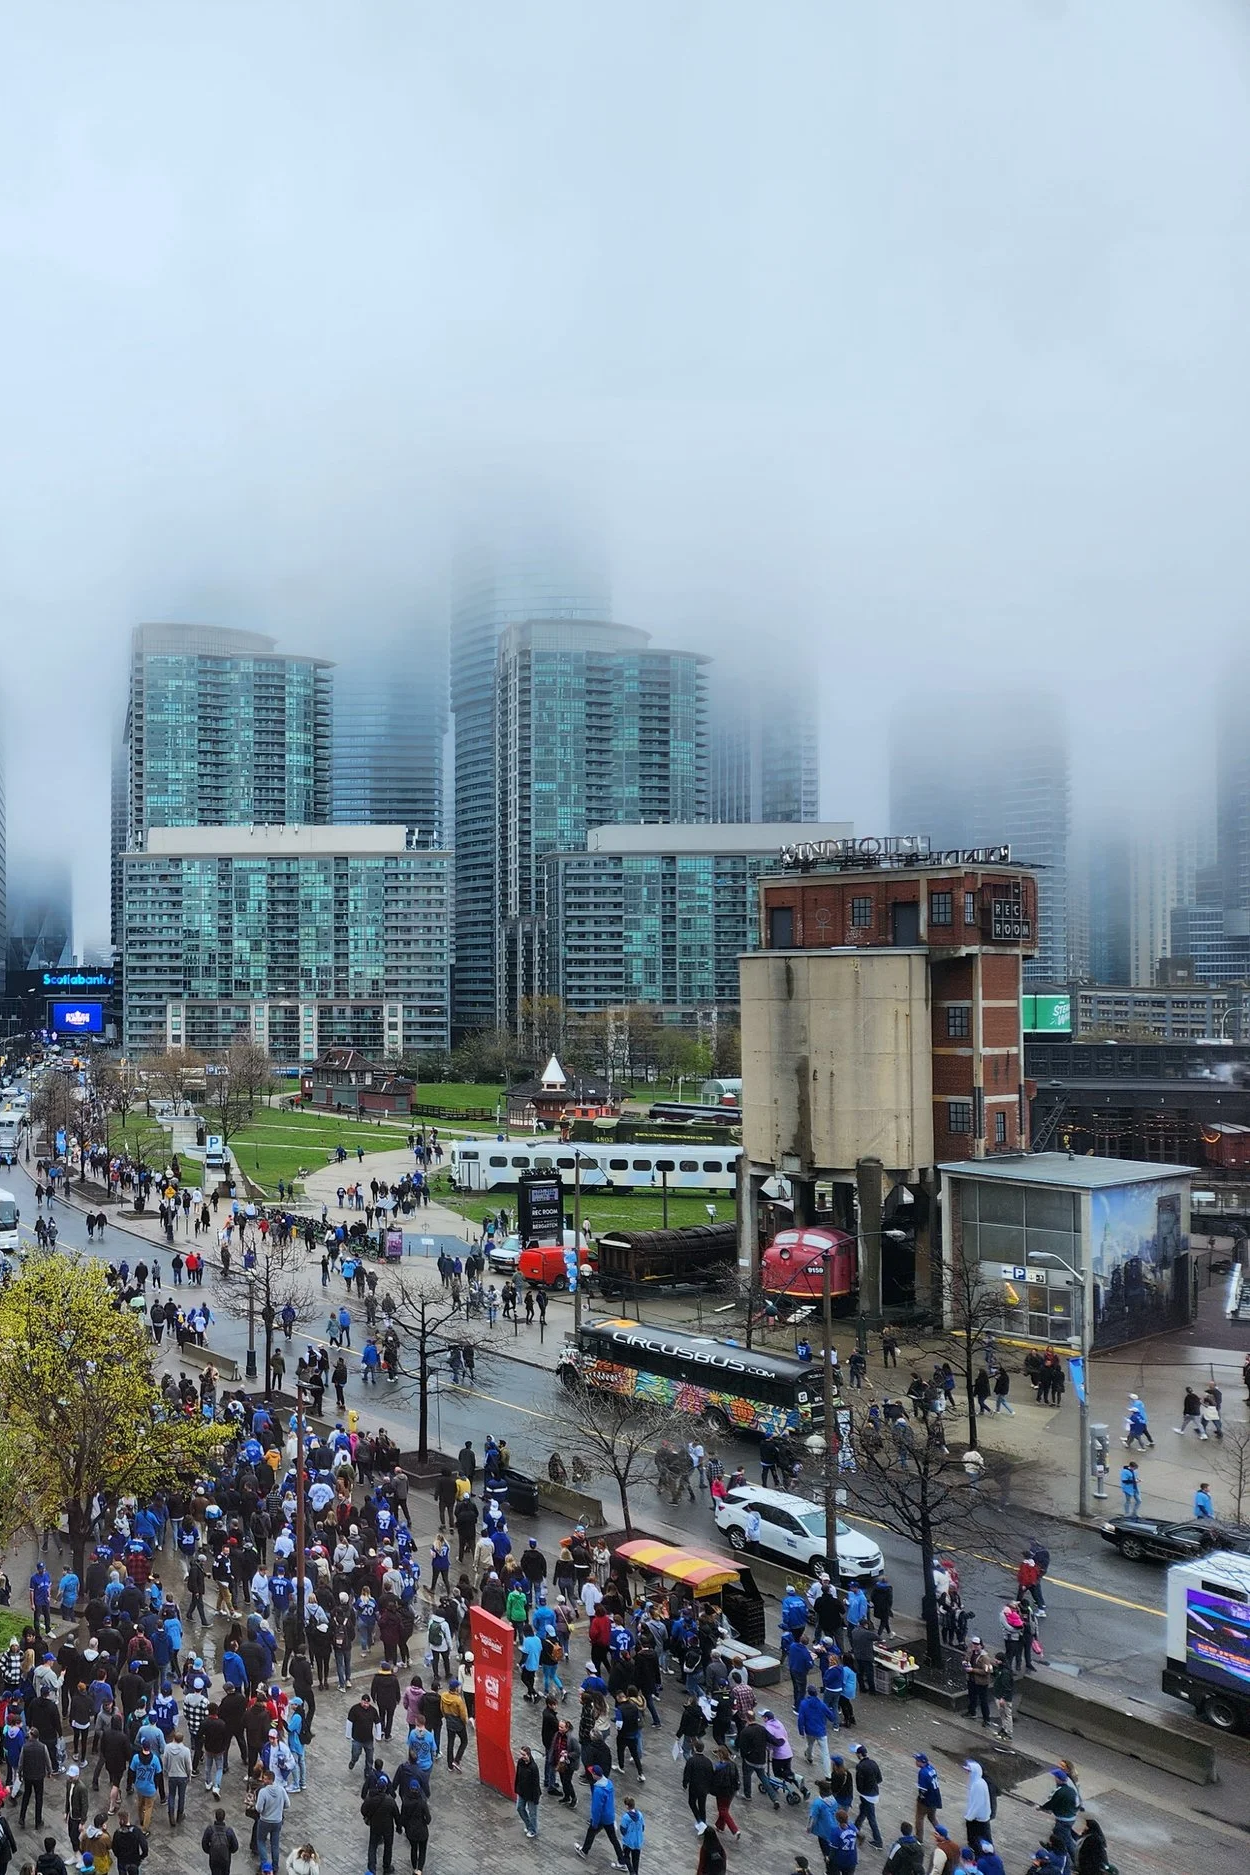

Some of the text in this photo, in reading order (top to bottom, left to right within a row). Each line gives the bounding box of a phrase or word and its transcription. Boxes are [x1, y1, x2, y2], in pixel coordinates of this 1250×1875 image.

[995, 904, 1019, 916] REC
[995, 924, 1029, 936] ROOM
[43, 973, 106, 985] Scotiabank
[210, 1137, 218, 1148] P
[1015, 1268, 1024, 1279] P
[613, 1332, 776, 1379] CIRCUSBUS.COM
[379, 1519, 390, 1530] 27
[275, 1585, 284, 1595] 11
[158, 1708, 168, 1719] 11
[842, 1837, 856, 1850] 27
